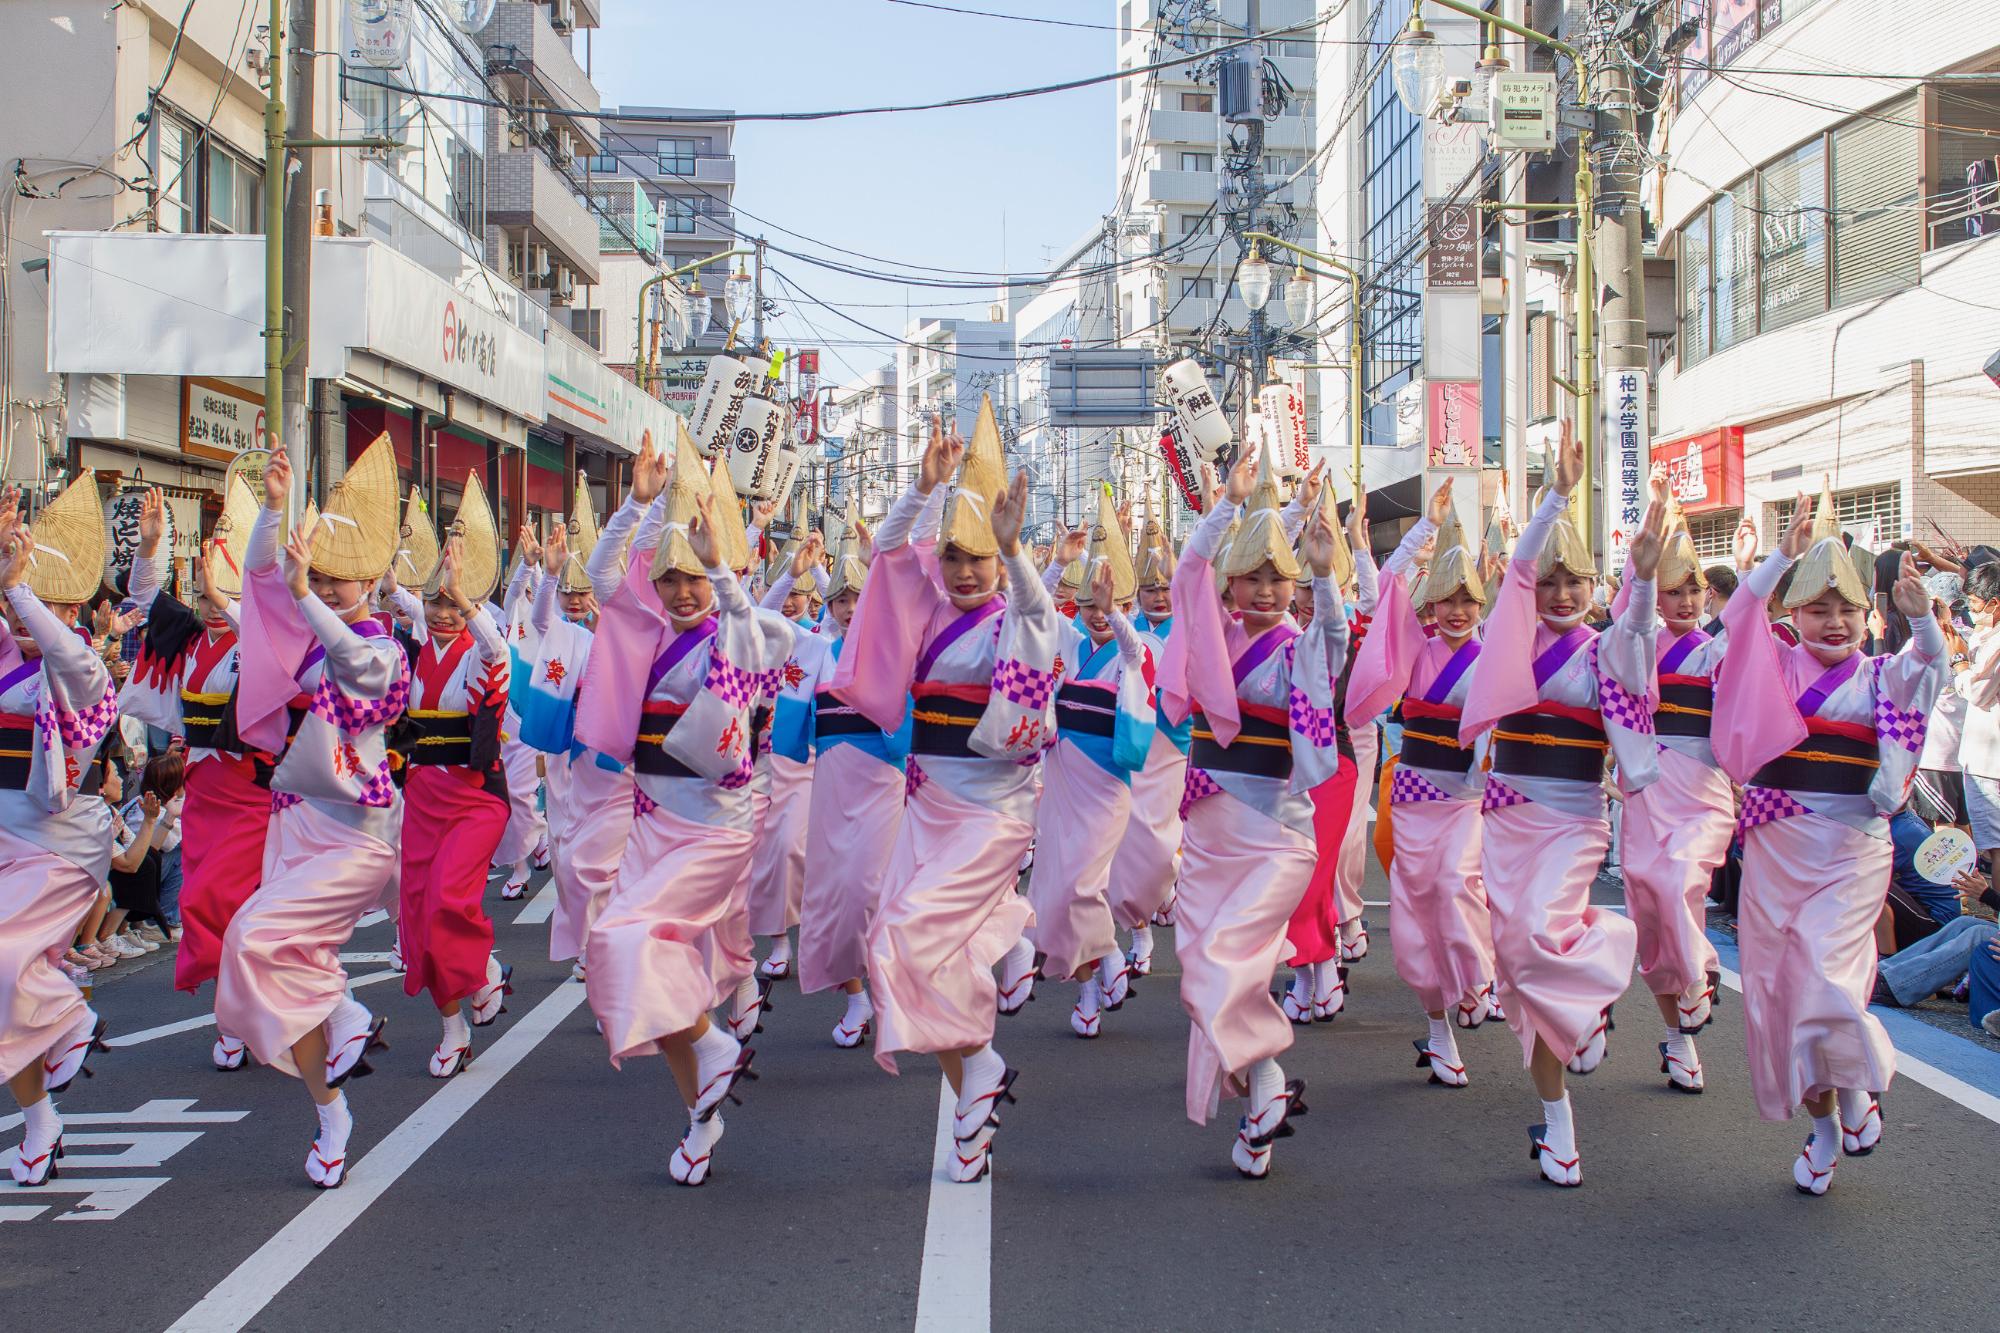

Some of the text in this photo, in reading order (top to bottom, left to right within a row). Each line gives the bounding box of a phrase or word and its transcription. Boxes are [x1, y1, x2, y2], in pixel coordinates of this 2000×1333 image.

[1503, 84, 1544, 92] 防犯カメラ
[1508, 95, 1539, 104] 作動中
[664, 391, 699, 401] 大和駅前
[212, 423, 232, 446] 焼とん
[234, 427, 253, 450] 焼とり
[1619, 375, 1640, 525] 柏木学園高等学校
